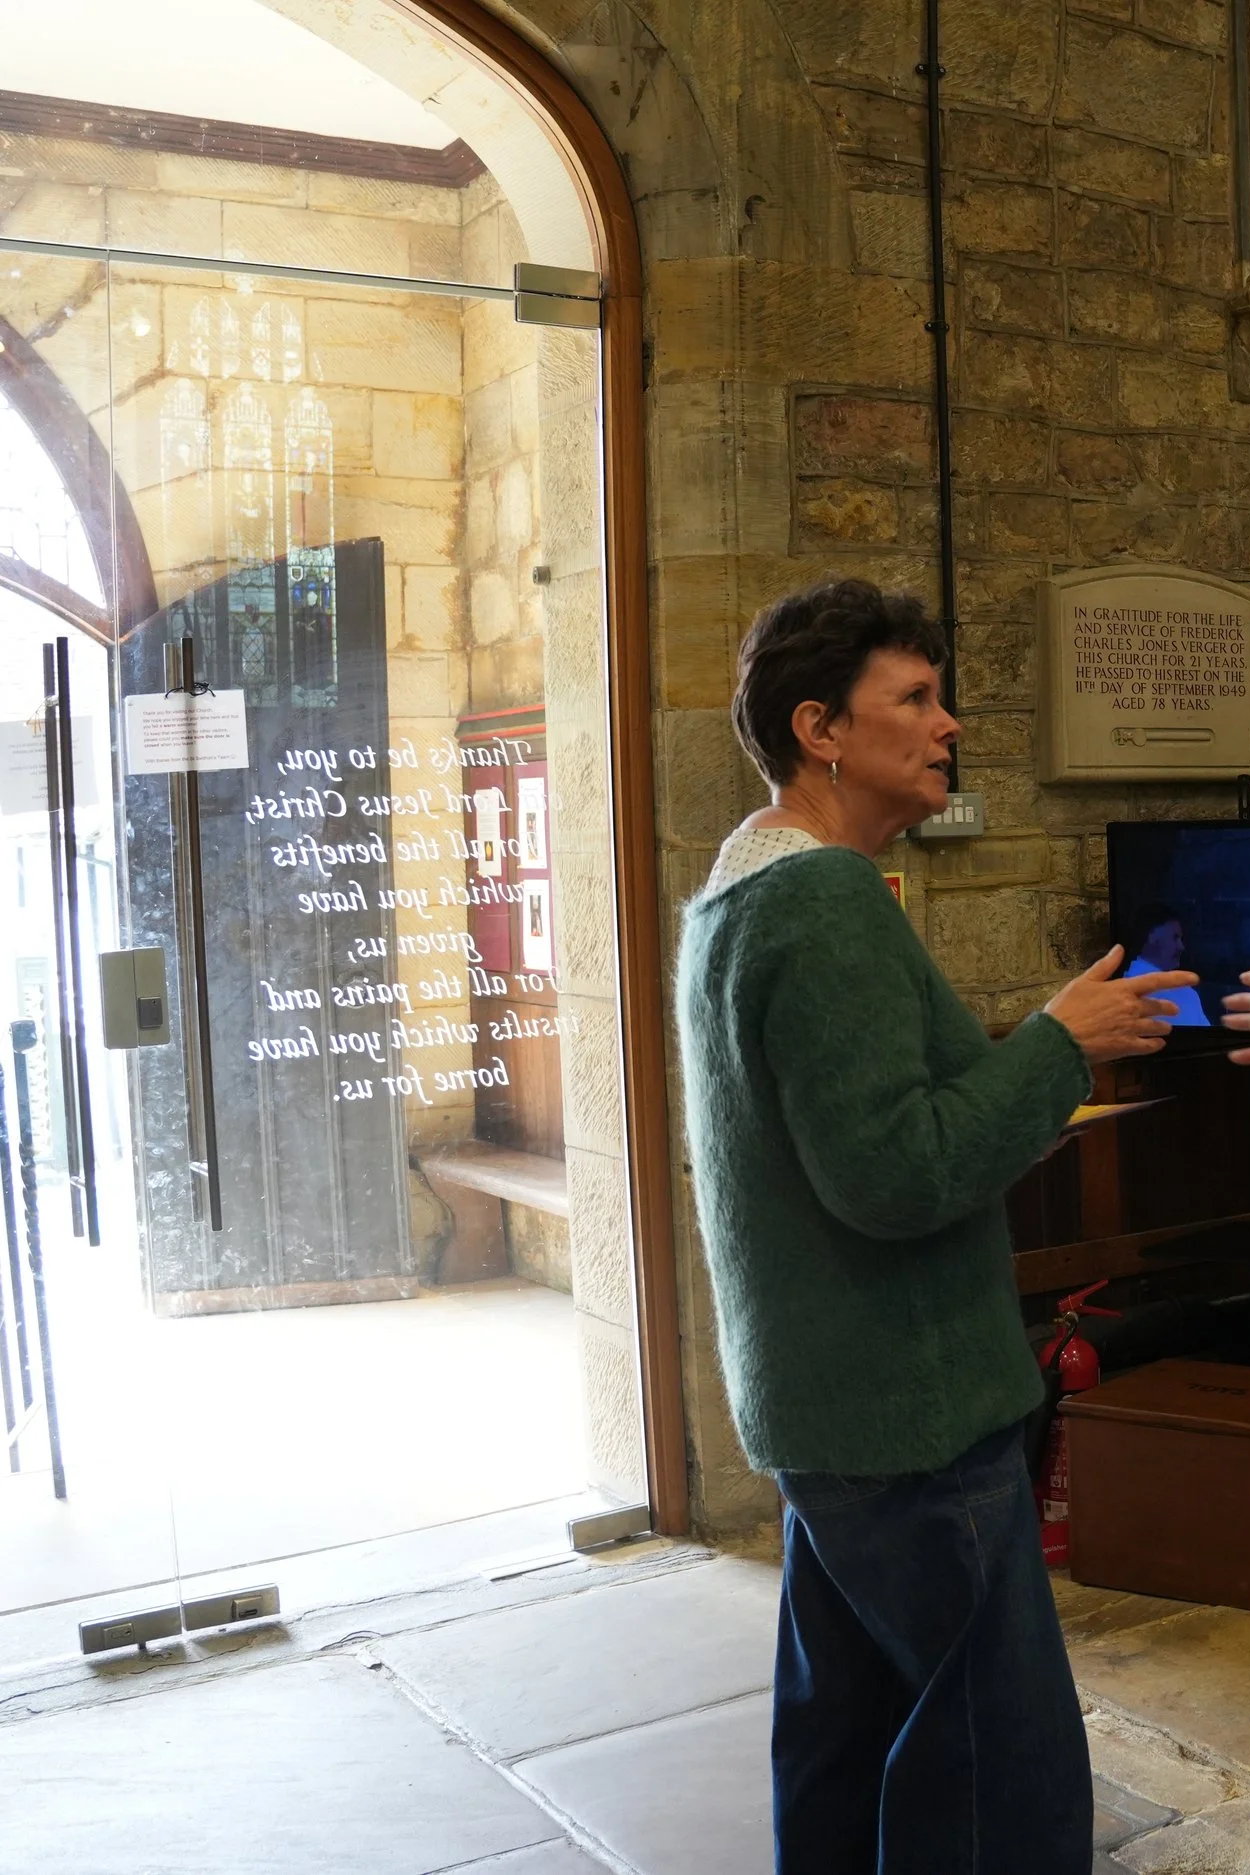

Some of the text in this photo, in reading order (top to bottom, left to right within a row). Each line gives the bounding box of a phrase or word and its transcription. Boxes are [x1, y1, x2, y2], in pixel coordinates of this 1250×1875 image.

[1074, 606, 1242, 627] IN GRATITUDE FOR THE LIFE
[1074, 622, 1245, 641] AND SERVICE OF FREDERICK
[1074, 636, 1245, 655] CHARLES JONES, VERGER OF
[1075, 651, 1249, 669] THIS CHURCH FOR 21 YEARS.
[1076, 666, 1245, 683] HE PASSED TO HIS REST ON THE
[1100, 681, 1125, 694] DAY
[1131, 682, 1147, 695] OF
[1151, 683, 1215, 696] SEPTEMBER
[1219, 684, 1246, 697] 1949
[1112, 697, 1214, 711] AGED 78 YEARS.
[1186, 1382, 1249, 1396] TOYS
